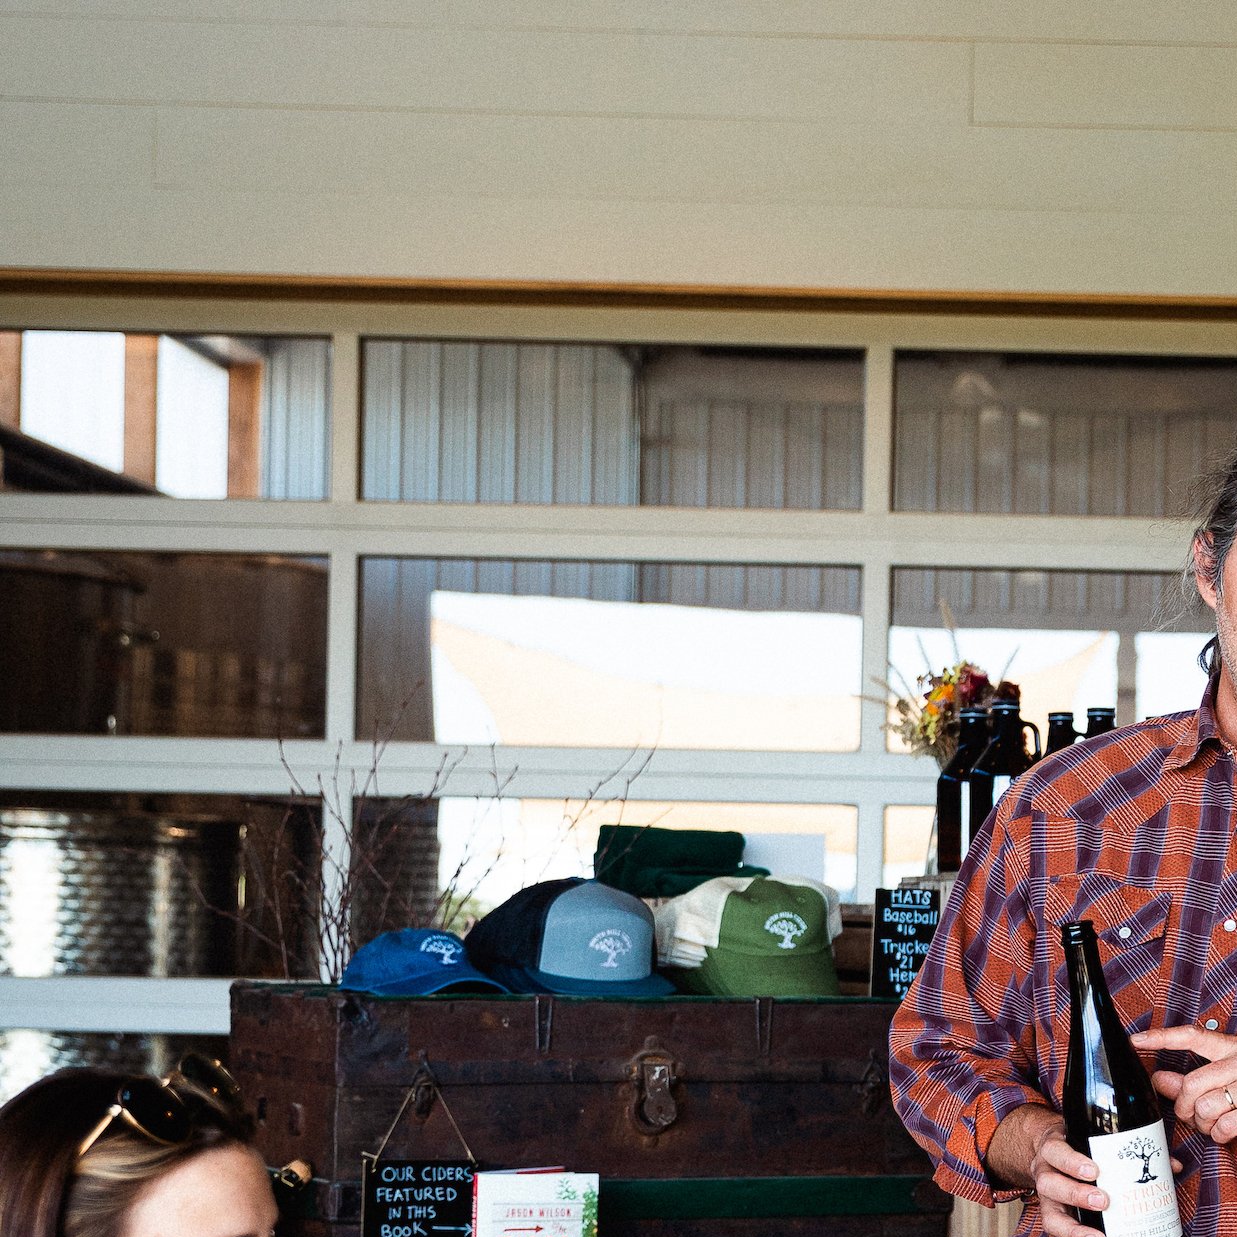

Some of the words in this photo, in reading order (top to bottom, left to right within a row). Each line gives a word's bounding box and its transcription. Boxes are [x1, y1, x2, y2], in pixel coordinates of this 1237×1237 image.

[891, 890, 932, 905] HATS
[883, 908, 938, 925] Baseball
[897, 923, 916, 936] $16
[881, 938, 930, 955] Trucke
[895, 952, 913, 969] $21
[381, 1166, 416, 1182] OUR
[421, 1166, 474, 1184] CIDERS
[376, 1186, 457, 1203] FEATURED
[388, 1206, 402, 1220] IN
[407, 1205, 437, 1219] THIS
[505, 1208, 533, 1218] JASON
[539, 1207, 572, 1218] WILSON
